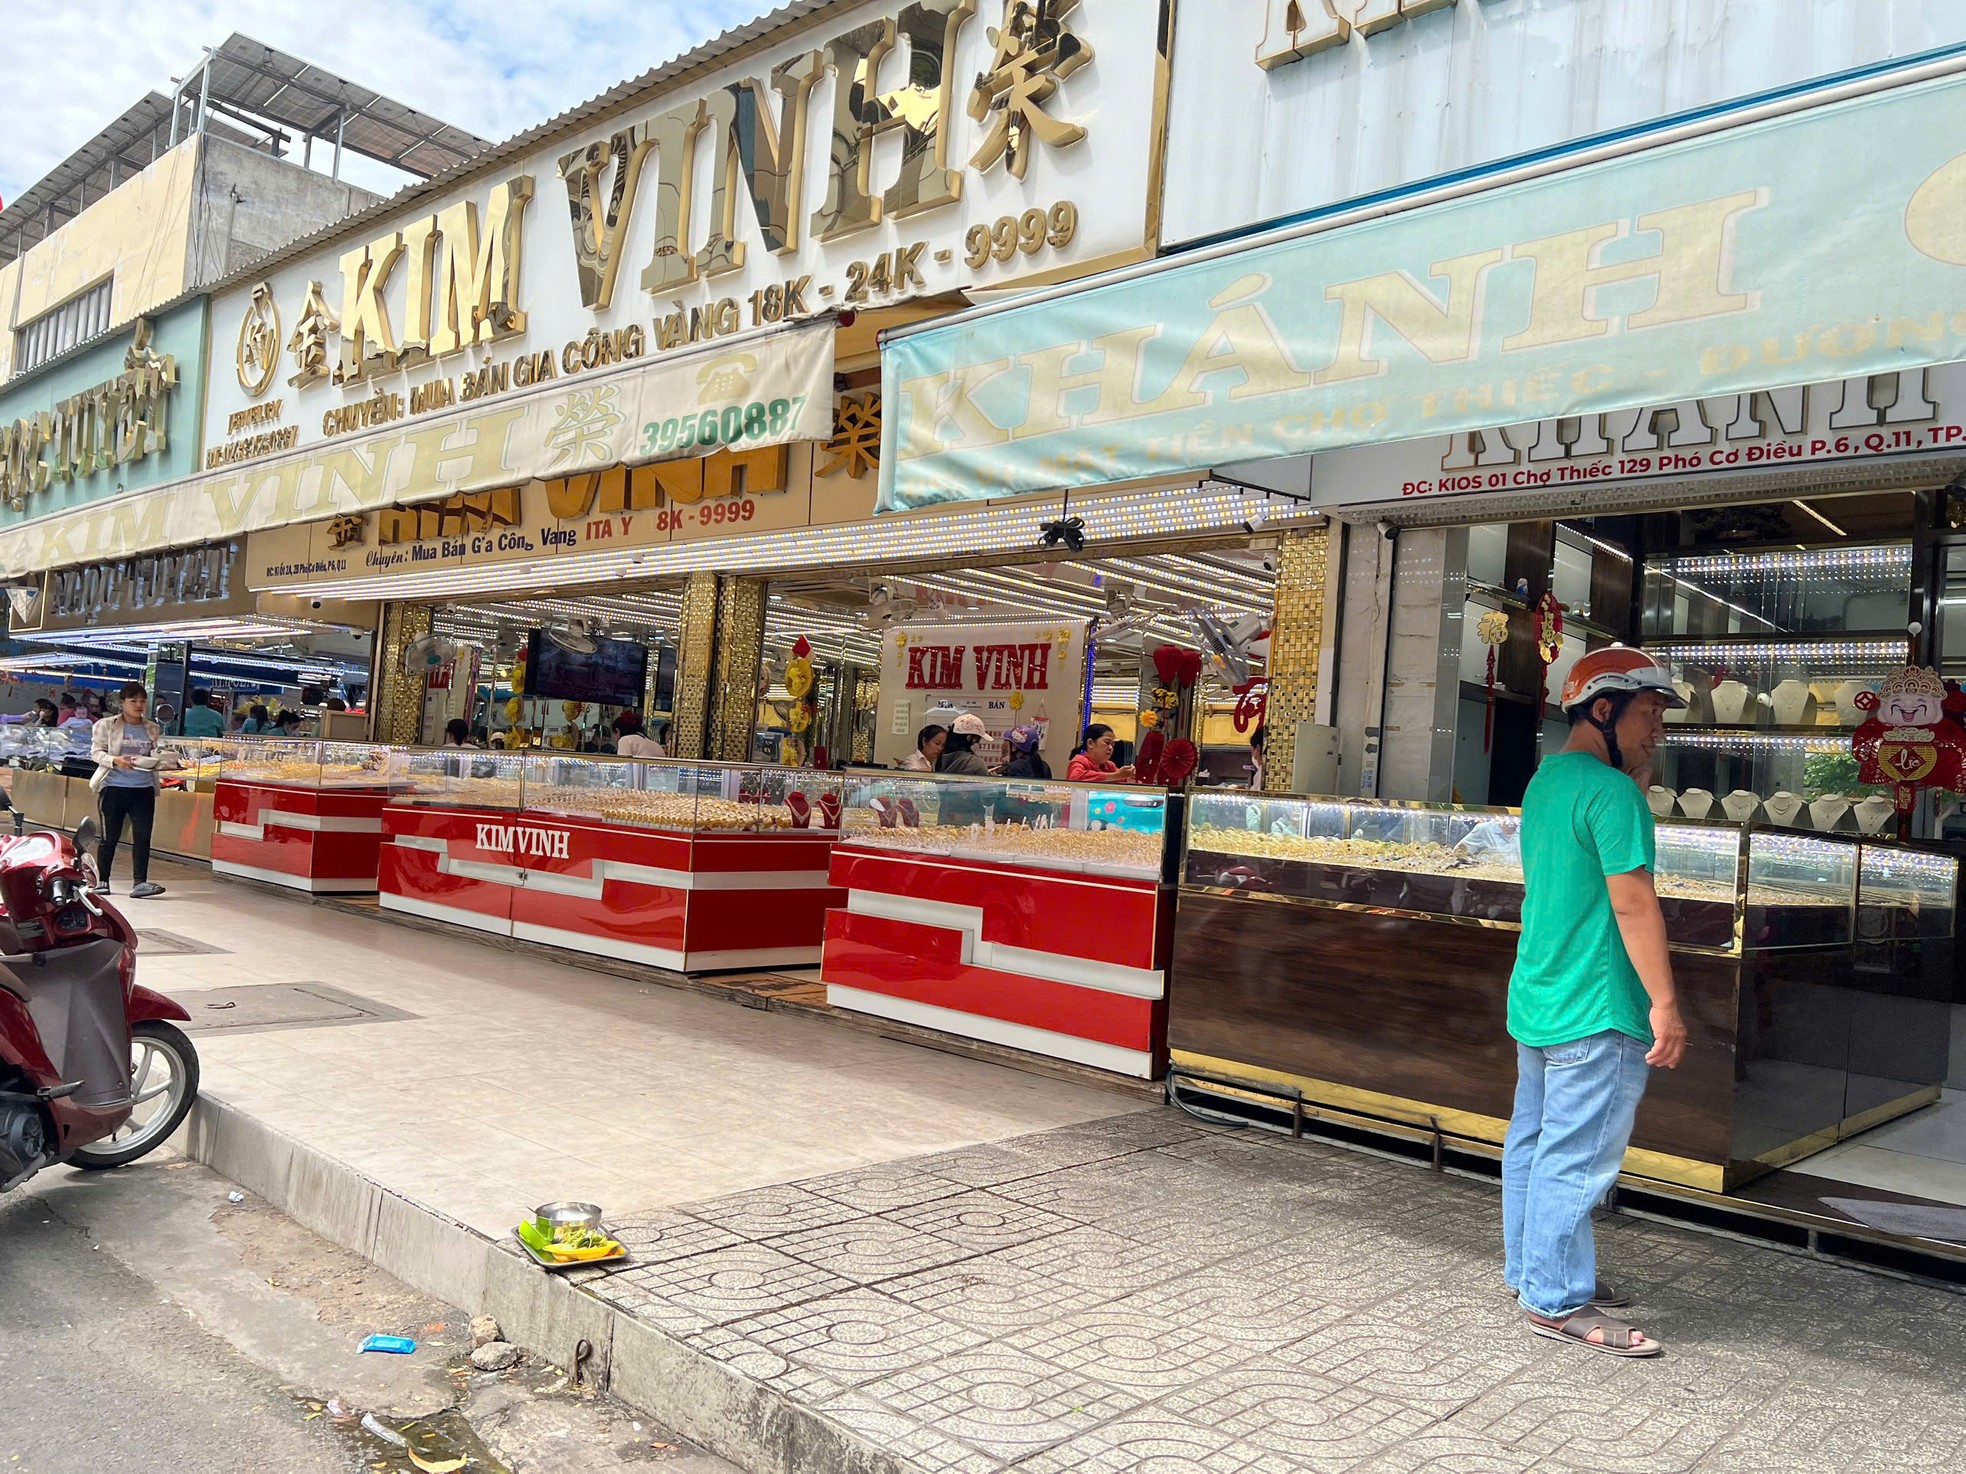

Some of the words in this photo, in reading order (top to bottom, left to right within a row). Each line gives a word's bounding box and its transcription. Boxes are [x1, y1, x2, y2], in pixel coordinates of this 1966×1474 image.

[332, 174, 534, 389] KIM
[556, 0, 976, 311] VINH
[460, 355, 510, 401] BÁN
[513, 348, 558, 389] GIA
[562, 324, 647, 375] CÔNG
[653, 299, 741, 351] VÀNG
[747, 273, 814, 322] 18K
[844, 240, 930, 303] 24K
[964, 199, 1079, 271] 9999
[896, 186, 1771, 463] KHÁNH
[639, 395, 810, 457] 39560887
[36, 492, 178, 570] KIM
[203, 403, 528, 534] VINH
[1401, 479, 1433, 496] ĐC:
[1438, 474, 1482, 492] KIOS
[1488, 471, 1507, 488] 01
[1512, 468, 1552, 488] Chợ
[1618, 456, 1652, 475] 129
[1657, 450, 1702, 471] Phó
[1709, 449, 1739, 467] Cơ
[1746, 440, 1803, 462] Điều
[411, 544, 437, 562] Mua
[441, 540, 466, 558] Bán
[699, 498, 756, 527] 9999
[905, 645, 966, 690] KIM
[973, 643, 1052, 690] VINH
[988, 699, 1005, 709] BÁN
